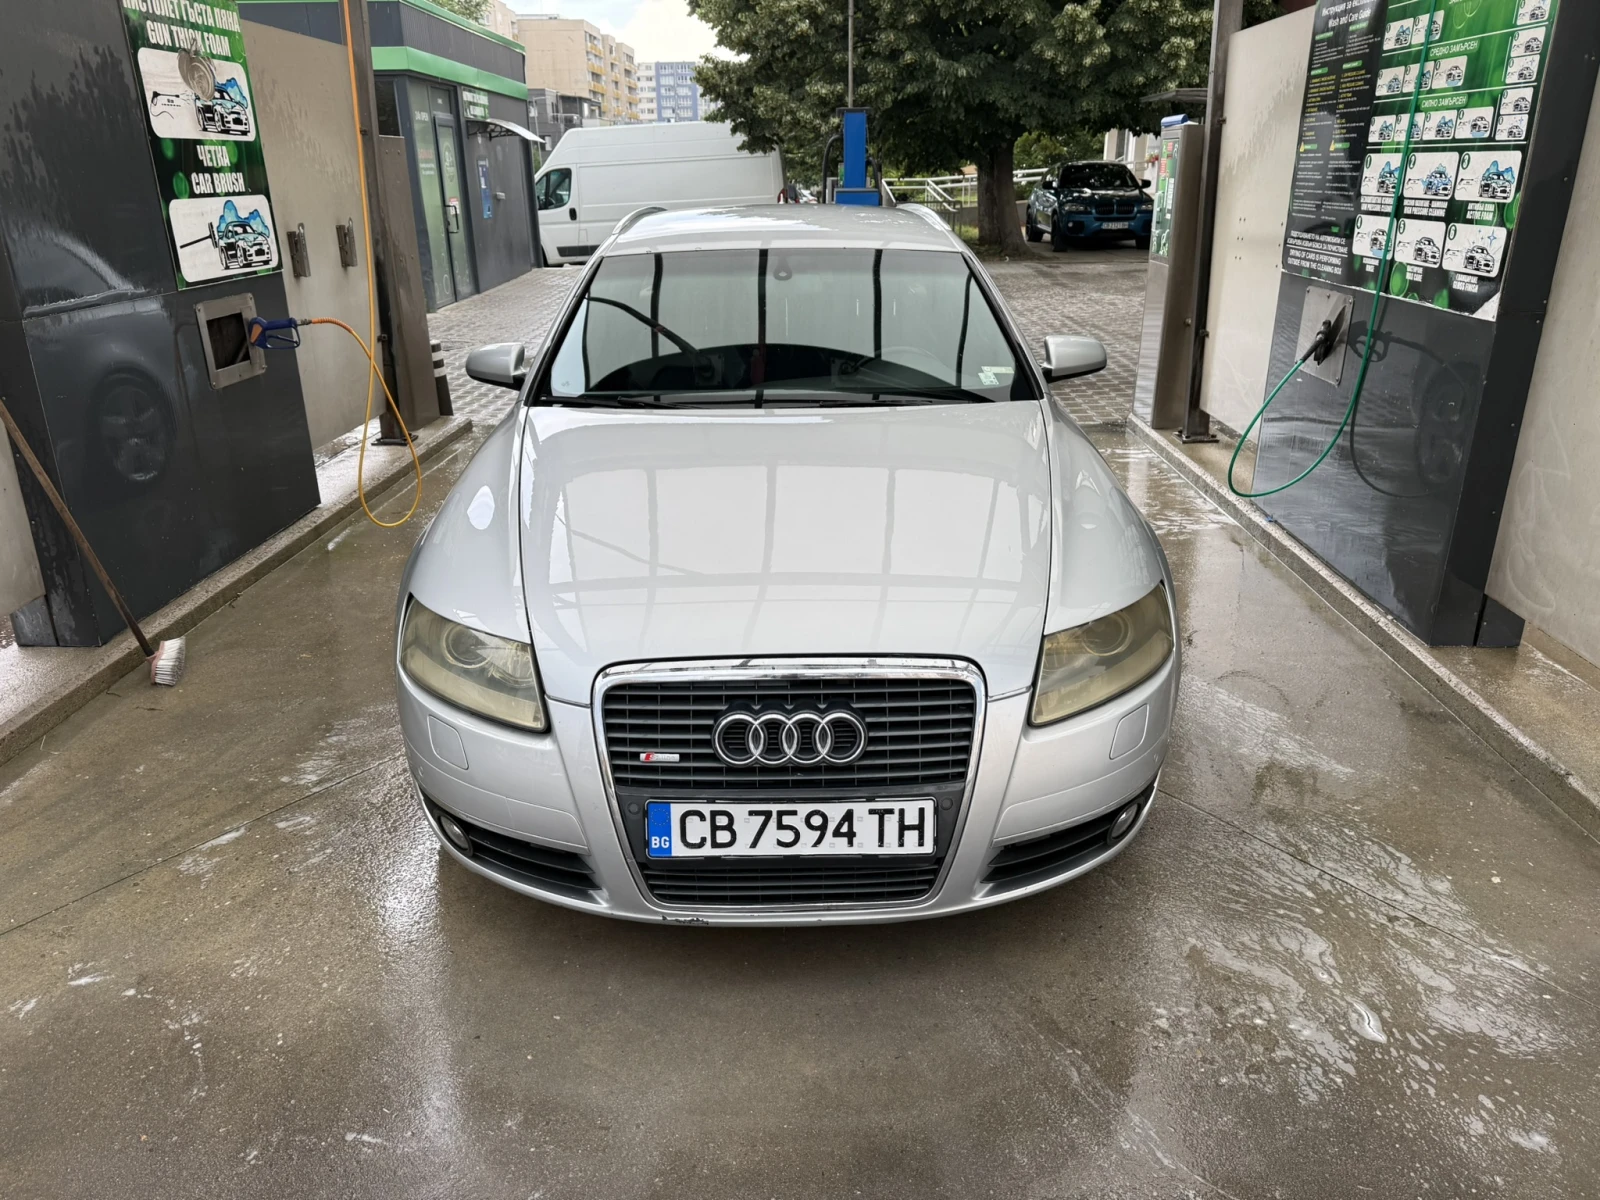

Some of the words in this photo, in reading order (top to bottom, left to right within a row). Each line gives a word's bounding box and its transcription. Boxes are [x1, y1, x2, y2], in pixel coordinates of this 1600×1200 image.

[181, 0, 215, 26] ГЪСТА
[214, 7, 241, 32] ПЯНА
[1328, 17, 1339, 28] Wash
[1340, 14, 1348, 25] and
[1348, 12, 1358, 23] Care
[1359, 7, 1371, 20] Guide
[146, 20, 172, 46] GUN
[204, 33, 231, 57] FOAM
[1429, 45, 1448, 57] СРЕДНО
[1448, 40, 1479, 54] ЗАМЪРСЕН
[1438, 96, 1467, 107] ЗАМЪРСЕН
[196, 145, 231, 167] ЧЕТКА
[191, 172, 214, 194] CAR
[212, 172, 245, 193] BRUSH
[1466, 210, 1481, 220] ACTIVE
[1481, 211, 1493, 221] FOAM
[1301, 259, 1310, 268] FROM
[1317, 263, 1333, 273] CLEANING
[679, 809, 737, 849] CB
[748, 808, 857, 849] 7594
[868, 807, 925, 848] TH
[651, 837, 670, 849] BG
